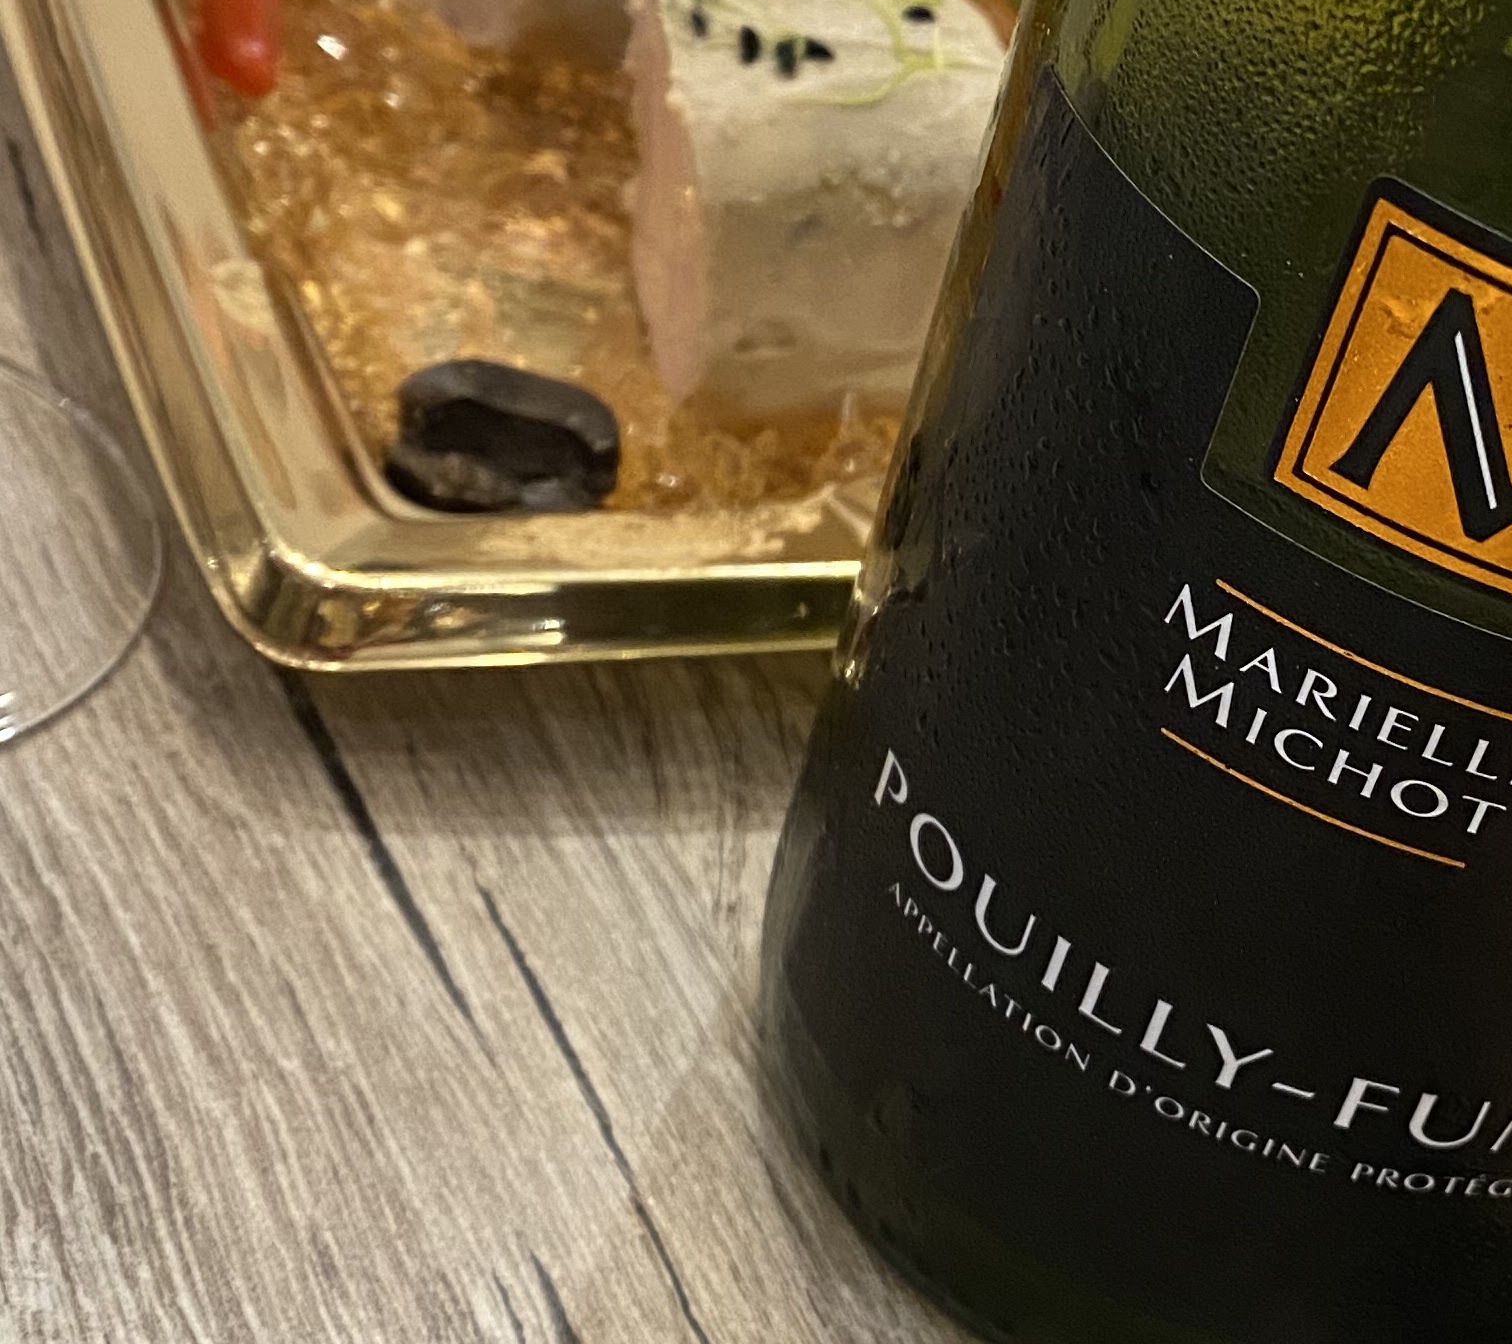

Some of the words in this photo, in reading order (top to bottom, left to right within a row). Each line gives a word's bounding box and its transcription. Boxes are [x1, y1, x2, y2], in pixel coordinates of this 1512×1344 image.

[1163, 653, 1507, 835] MICHOT
[887, 880, 1092, 1072] APPELLATION
[1108, 1069, 1332, 1174] D'ORIGINE
